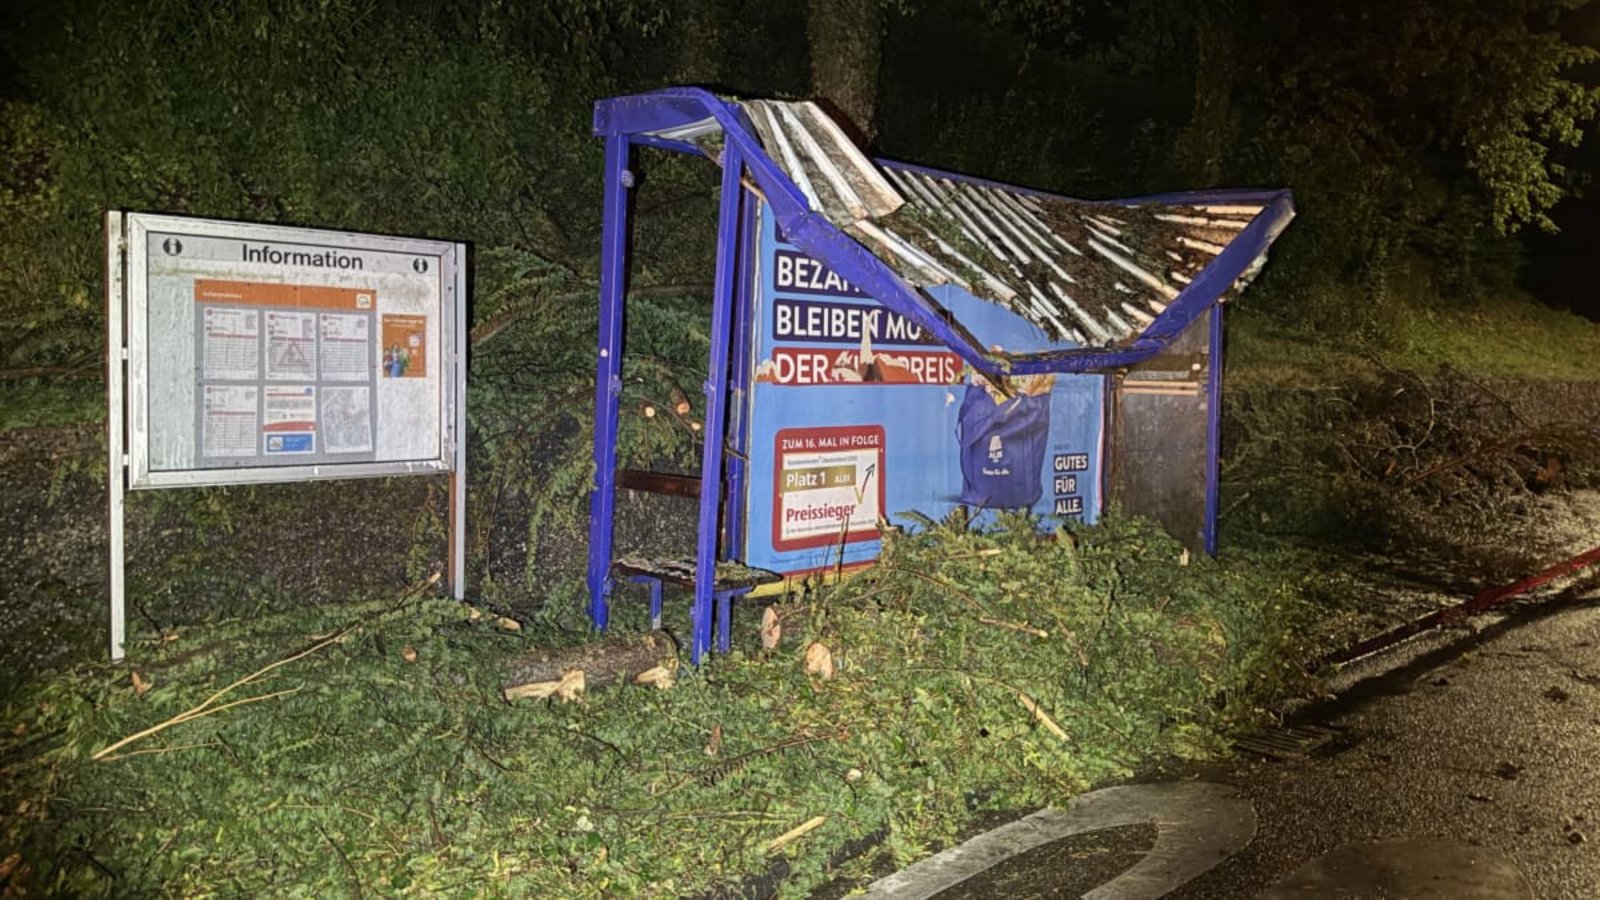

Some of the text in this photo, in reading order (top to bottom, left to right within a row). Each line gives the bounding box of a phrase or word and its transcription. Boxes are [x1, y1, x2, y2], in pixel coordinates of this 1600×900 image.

[242, 244, 363, 270] Information
[778, 256, 860, 293] BEZA
[776, 305, 879, 340] BLEIBEN
[776, 353, 829, 383] DER
[782, 435, 879, 449] ZUM 16. MAL IN FOLGE
[1055, 455, 1087, 470] GUTES
[786, 472, 818, 487] Platz
[819, 471, 826, 485] 1
[1055, 475, 1076, 494] FÜR
[786, 502, 856, 523] Preissieger
[1055, 499, 1082, 515] ALLE.
